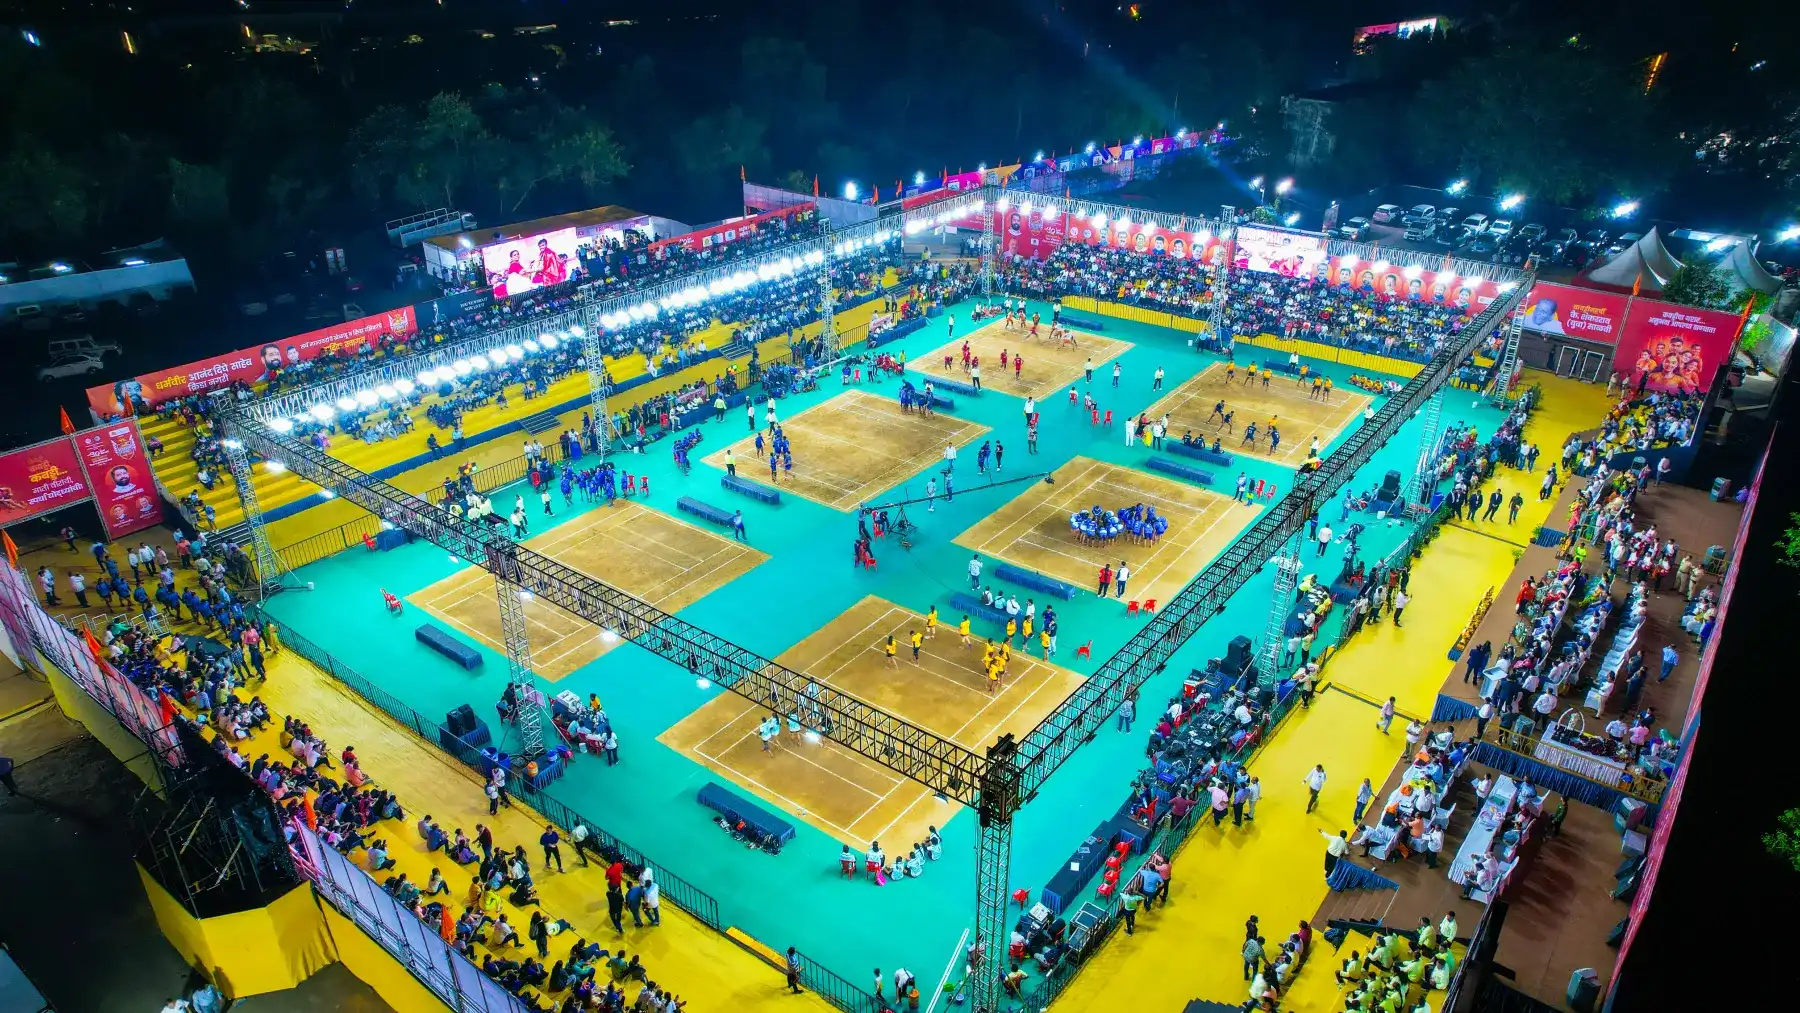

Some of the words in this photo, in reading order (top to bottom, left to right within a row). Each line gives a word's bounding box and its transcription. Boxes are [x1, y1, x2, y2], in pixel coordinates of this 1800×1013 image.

[156, 376, 187, 390] धर्मवीर
[188, 369, 213, 381] आनंद
[230, 358, 252, 370] साहेब
